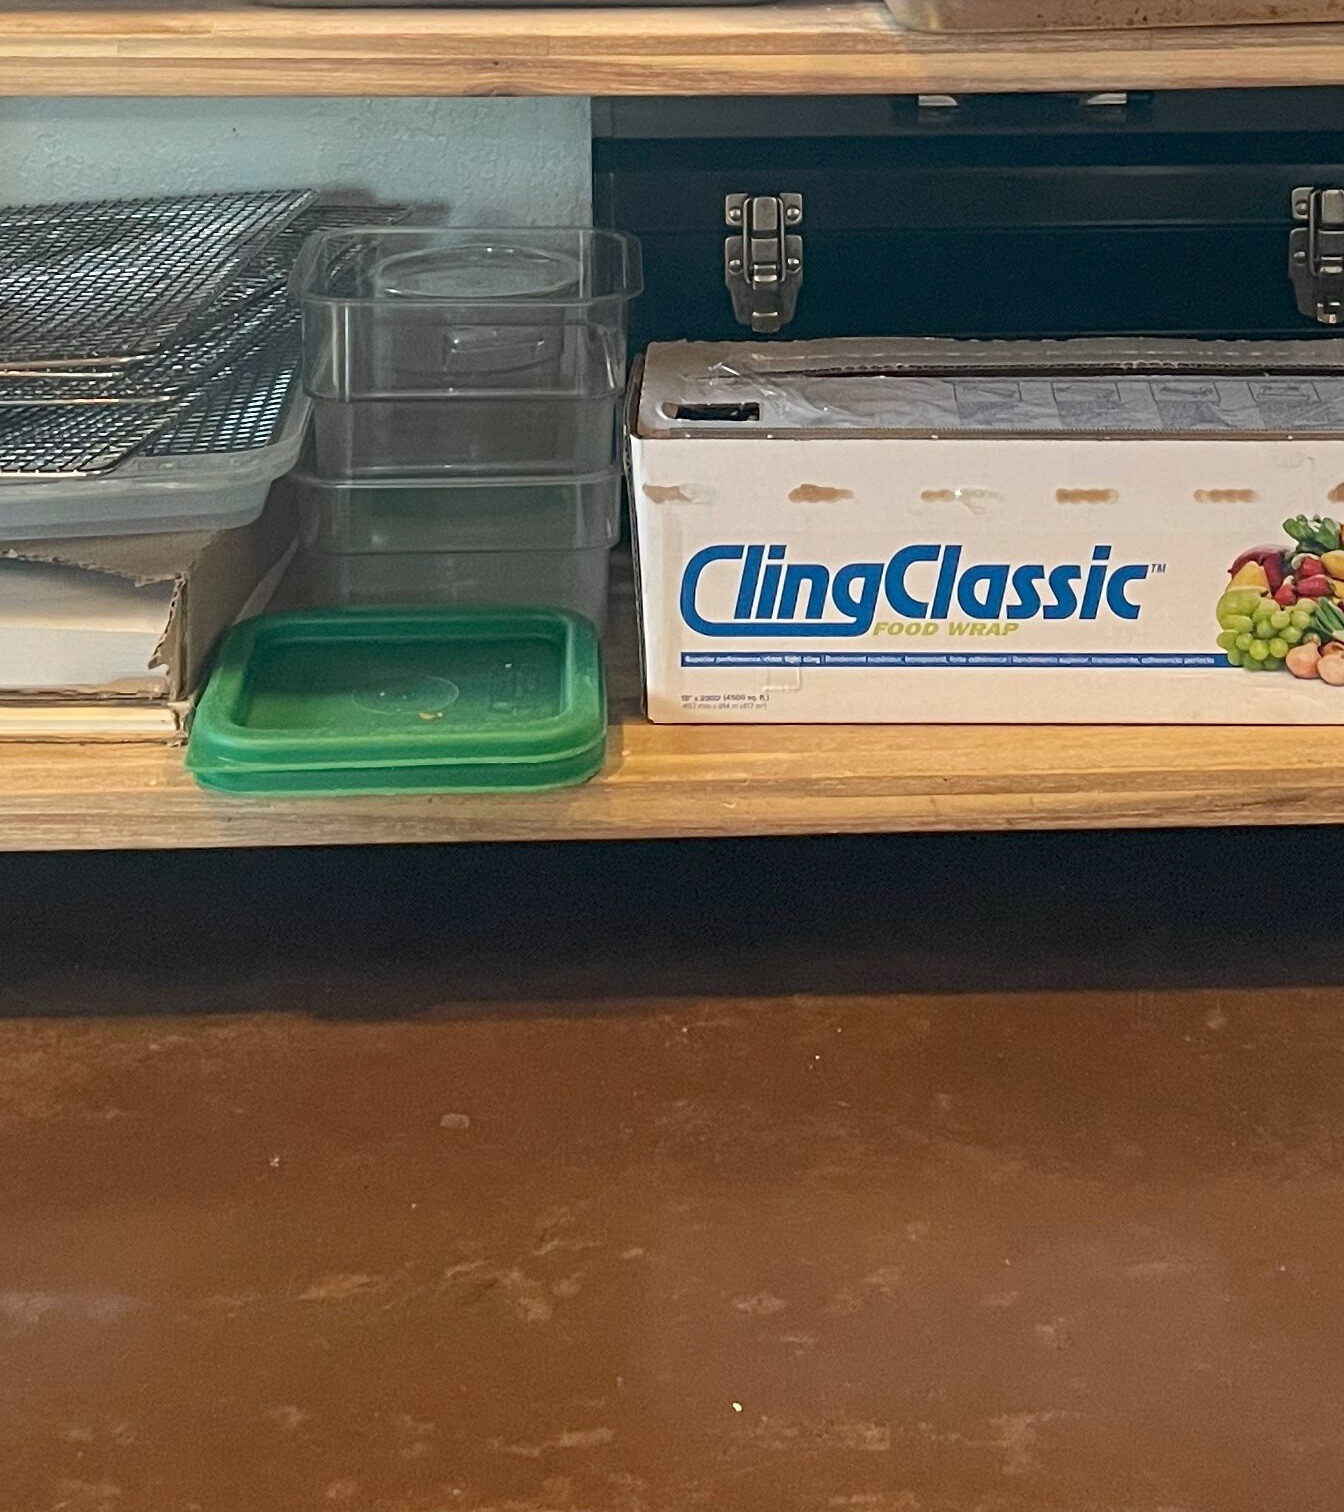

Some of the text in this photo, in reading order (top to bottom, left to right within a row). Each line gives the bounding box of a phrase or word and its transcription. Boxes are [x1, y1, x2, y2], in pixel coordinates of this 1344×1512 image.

[679, 544, 1149, 637] ClingClassic
[872, 621, 1020, 636] FOOD WRAP
